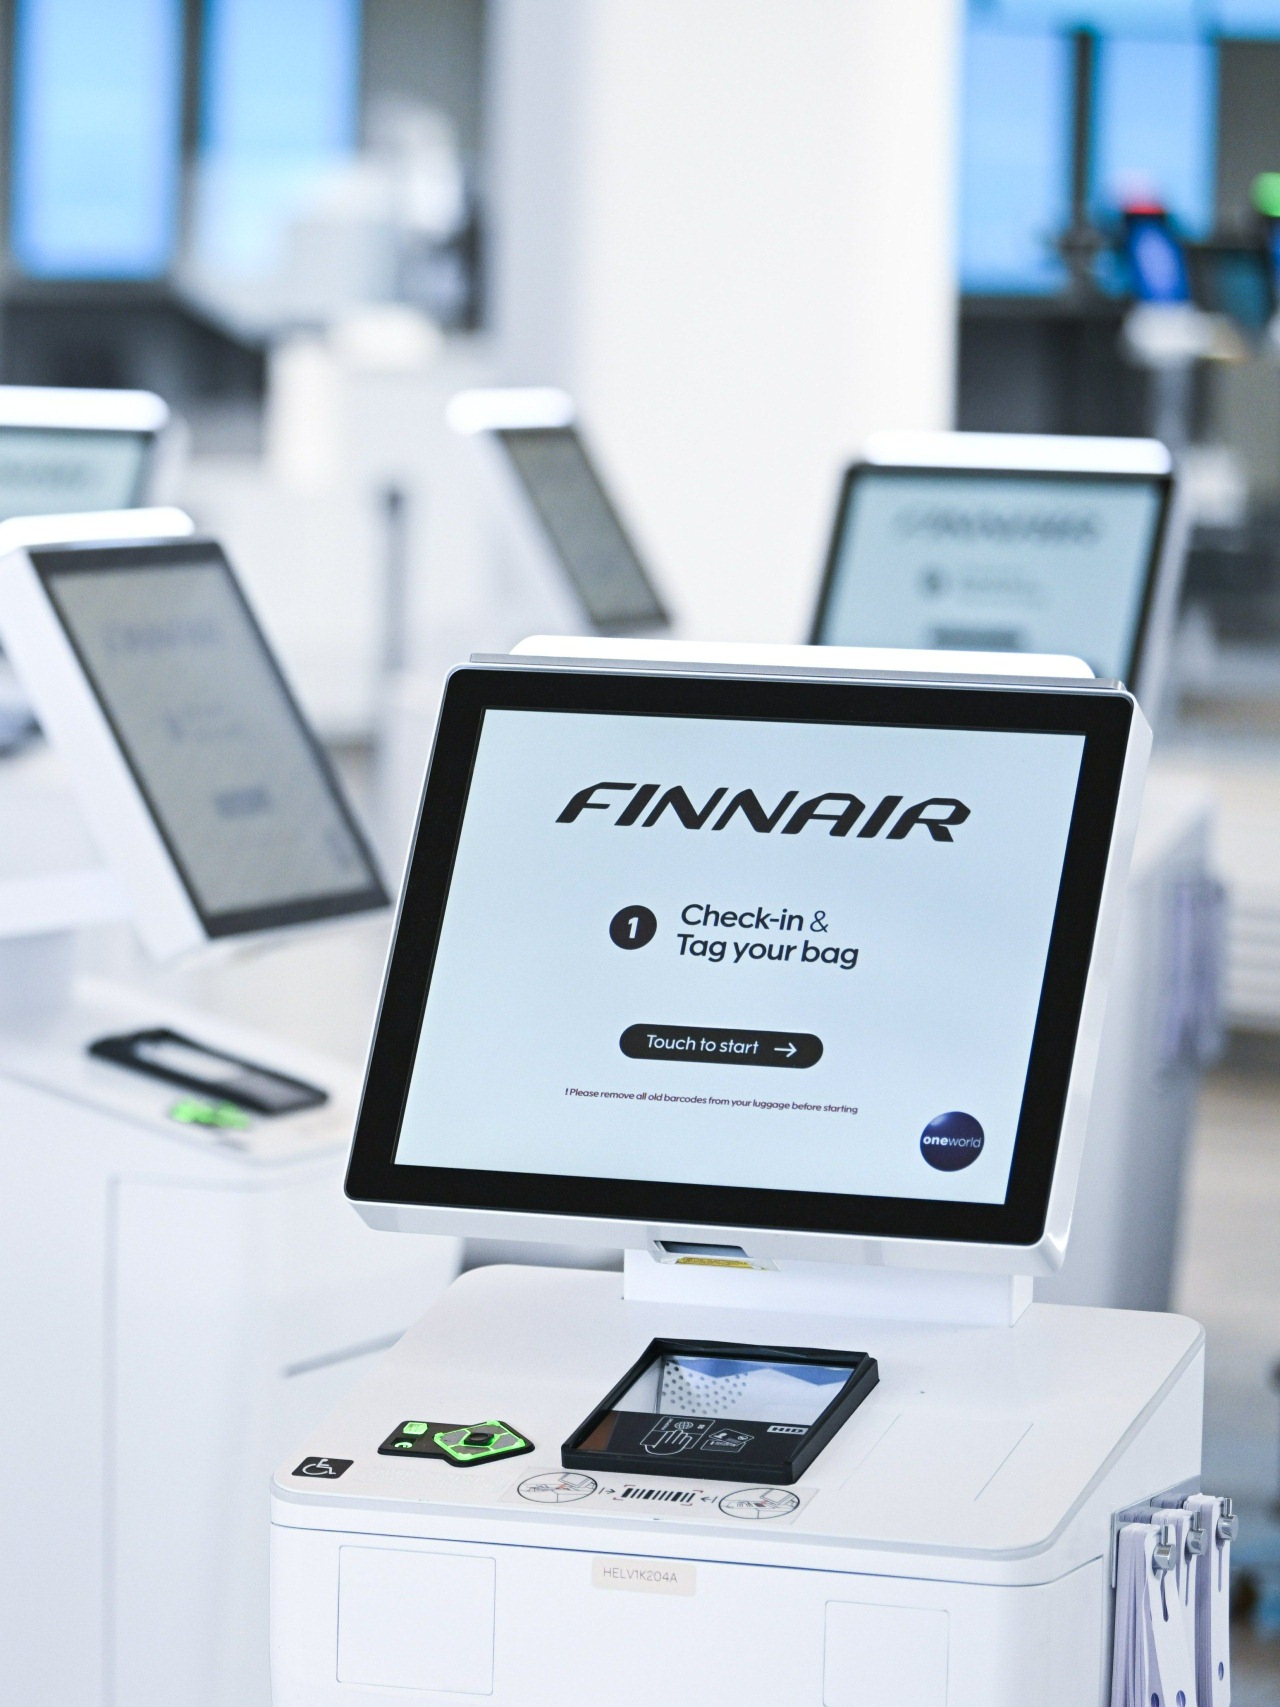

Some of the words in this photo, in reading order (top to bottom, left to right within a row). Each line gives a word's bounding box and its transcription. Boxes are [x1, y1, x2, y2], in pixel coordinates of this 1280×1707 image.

[555, 782, 971, 842] FINNAIR
[627, 916, 639, 939] 1
[681, 903, 804, 932] Check-in
[809, 910, 829, 933] &
[676, 933, 728, 963] Tag
[732, 941, 798, 964] your
[800, 939, 859, 970] bag
[646, 1034, 696, 1051] Touch
[699, 1038, 717, 1052] to
[719, 1039, 760, 1055] start
[569, 1088, 600, 1099] Please
[600, 1091, 635, 1101] remove
[635, 1092, 647, 1101] all
[648, 1092, 663, 1102] old
[663, 1093, 707, 1105] barcodes
[708, 1096, 730, 1106] from
[731, 1099, 752, 1108] your
[752, 1099, 791, 1111] luggage
[791, 1101, 822, 1112] before
[823, 1104, 859, 1115] starting
[922, 1135, 982, 1148] oneworld
[770, 1426, 806, 1435] HID
[602, 1567, 679, 1583] HELV1K204A
